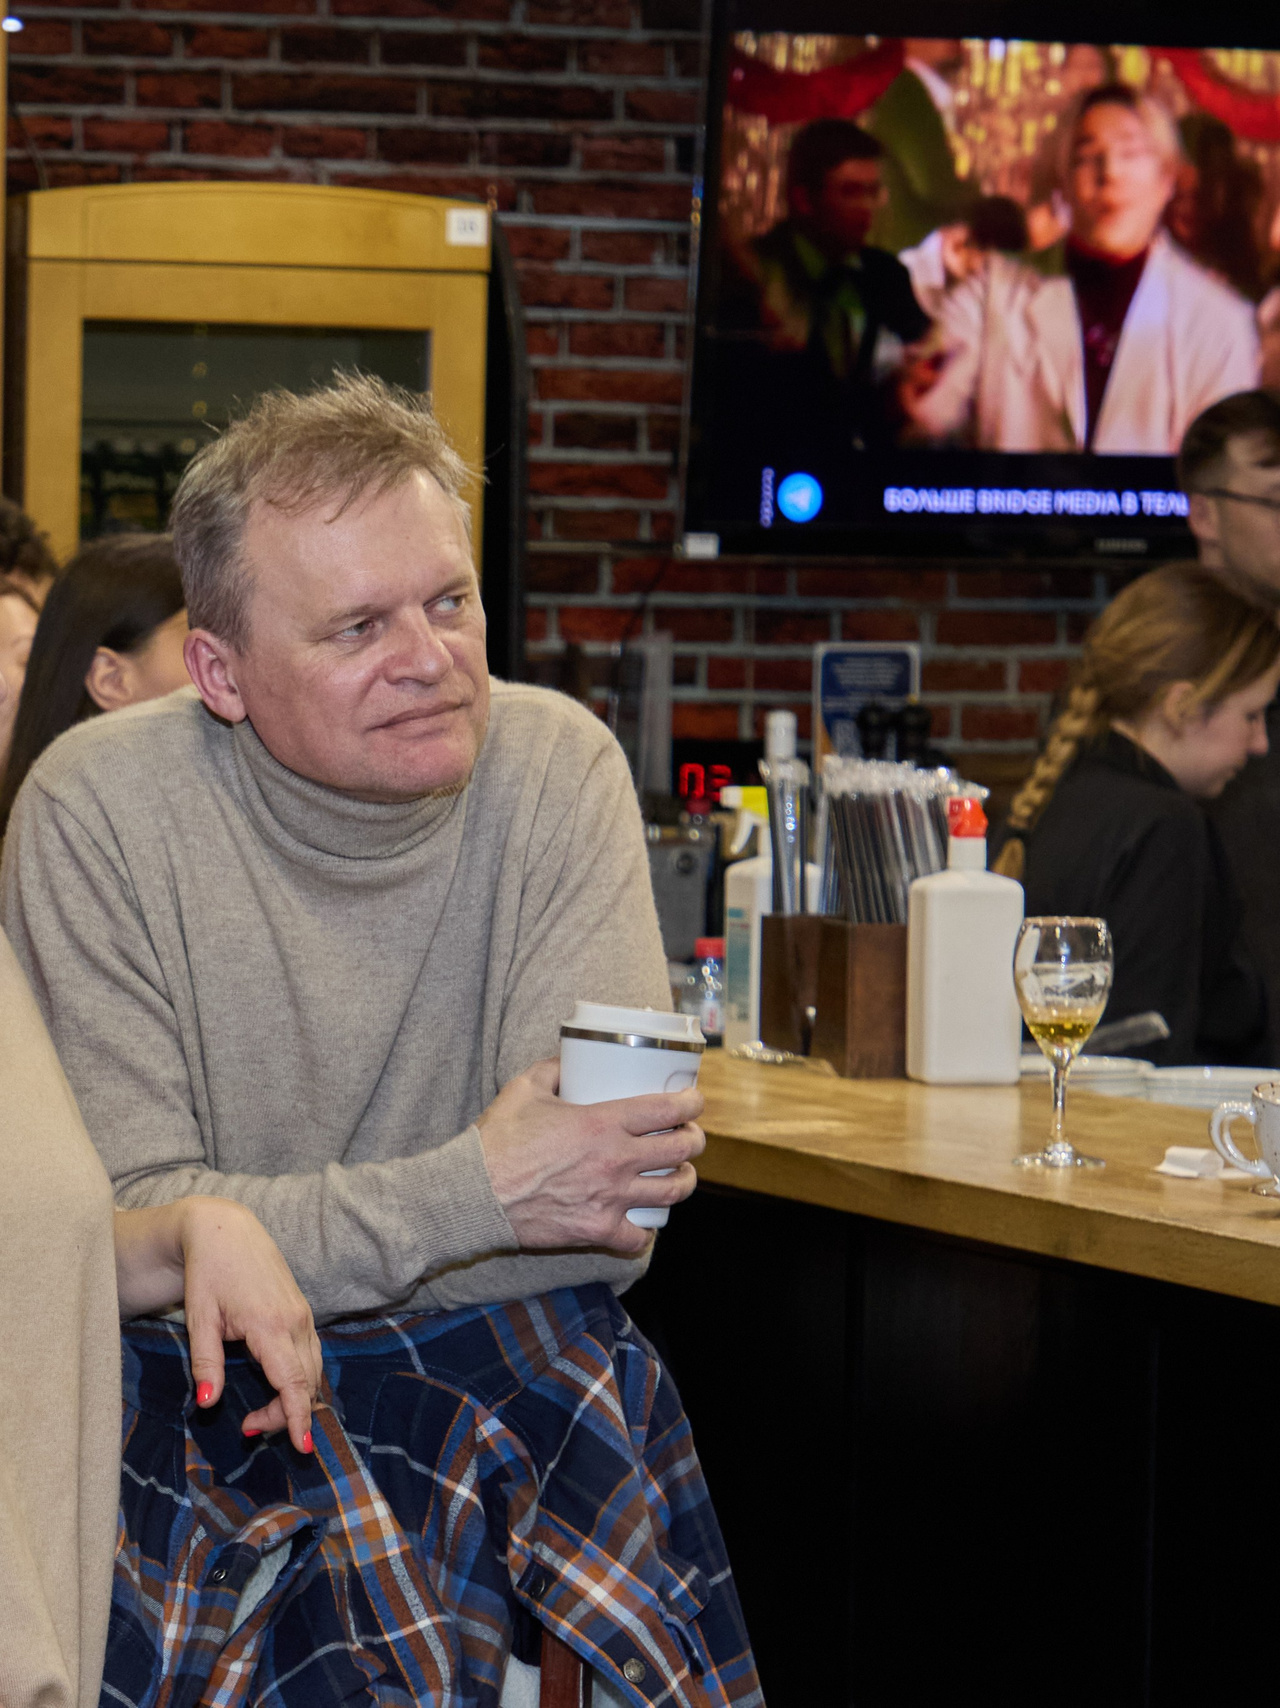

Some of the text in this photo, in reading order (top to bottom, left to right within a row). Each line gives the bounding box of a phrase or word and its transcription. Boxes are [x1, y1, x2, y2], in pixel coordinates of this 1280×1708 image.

[884, 489, 975, 513] БОЛЬШЕ
[977, 490, 1052, 514] BRIDGE
[1054, 491, 1120, 515] MEDIA
